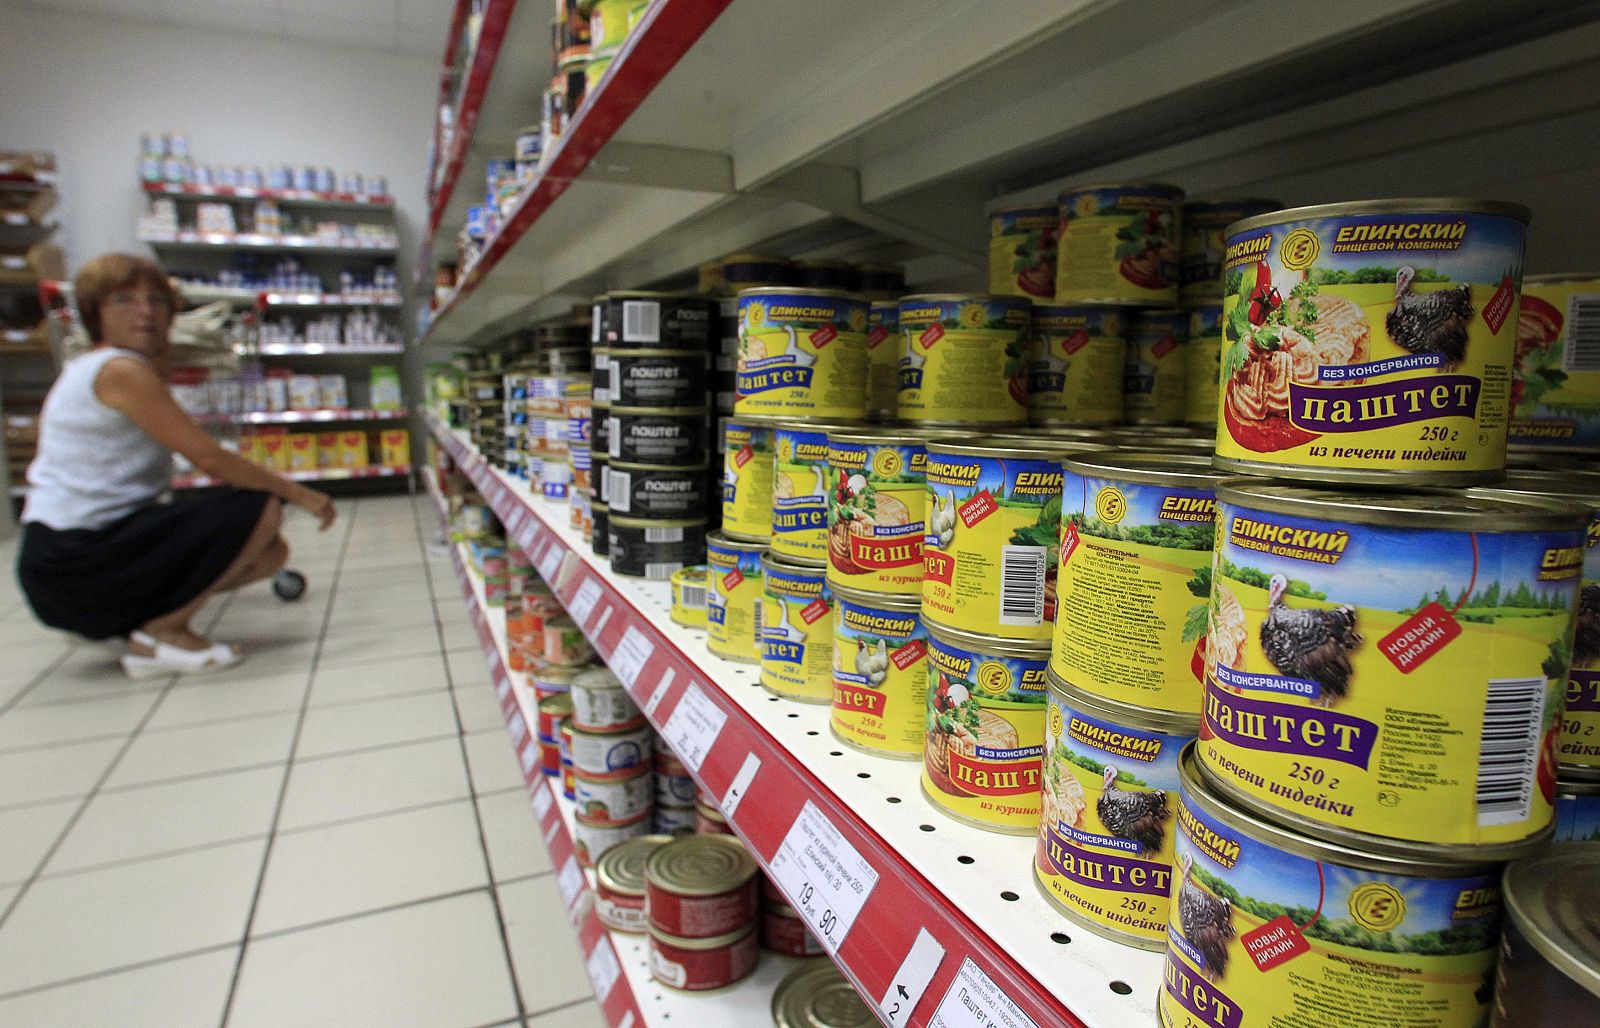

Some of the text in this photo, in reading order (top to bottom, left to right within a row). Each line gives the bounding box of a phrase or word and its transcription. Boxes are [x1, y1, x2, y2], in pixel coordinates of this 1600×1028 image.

[1336, 221, 1466, 242] ЕЛИНСКИЙ
[1334, 239, 1460, 252] ПИЩЕВОЙ КОМБИНАТ
[1322, 356, 1440, 378] БЕЗ КОНСЕРВАНТОВ
[1301, 383, 1472, 423] паштет
[1419, 426, 1458, 442] 250 г
[1309, 446, 1466, 462] из печени индейки
[1016, 473, 1064, 486] ЕЛИН
[1159, 512, 1212, 522] ПИЩЕВОЙ
[1161, 497, 1216, 513] ЕЛИН
[1232, 517, 1348, 553] ЕЛИНСКИЙ
[858, 541, 923, 563] пашт
[1231, 535, 1340, 564] ПИЩЕВОЙ КОМБИНАТ
[845, 610, 915, 632] ЕЛИНСКИЙ
[1387, 617, 1436, 655] НОВЫЙ
[1397, 627, 1445, 666] ДИЗАЙН
[1218, 668, 1313, 694] БЕЗ КОНСЕРВАНТОВ
[1208, 692, 1361, 752] паштет
[1069, 730, 1157, 762] ПИЩЕВОЙ КОМБИНАТ
[1070, 716, 1162, 755] ЕЛИНСКИЙ
[979, 745, 1043, 758] БЕЗ КОНСЕРВА
[956, 763, 1039, 789] пашт
[1208, 746, 1355, 817] из печени индейки
[1288, 762, 1340, 790] 250 г
[980, 801, 1040, 816] из курино
[1060, 823, 1138, 851] БЕЗ КОНСЕРВАНТОВ
[1050, 839, 1171, 889] паштет
[797, 879, 815, 906] 19
[818, 907, 838, 936] 90
[1052, 879, 1166, 933] из печени индейки
[1121, 897, 1157, 915] 250 г
[1247, 926, 1287, 952] НОВЫЙ
[1254, 938, 1295, 966] ДИЗАЙН
[965, 959, 977, 973] ЗАО
[1165, 955, 1231, 1028] штет
[889, 1003, 900, 1021] 2
[956, 986, 989, 1024] Паштет
